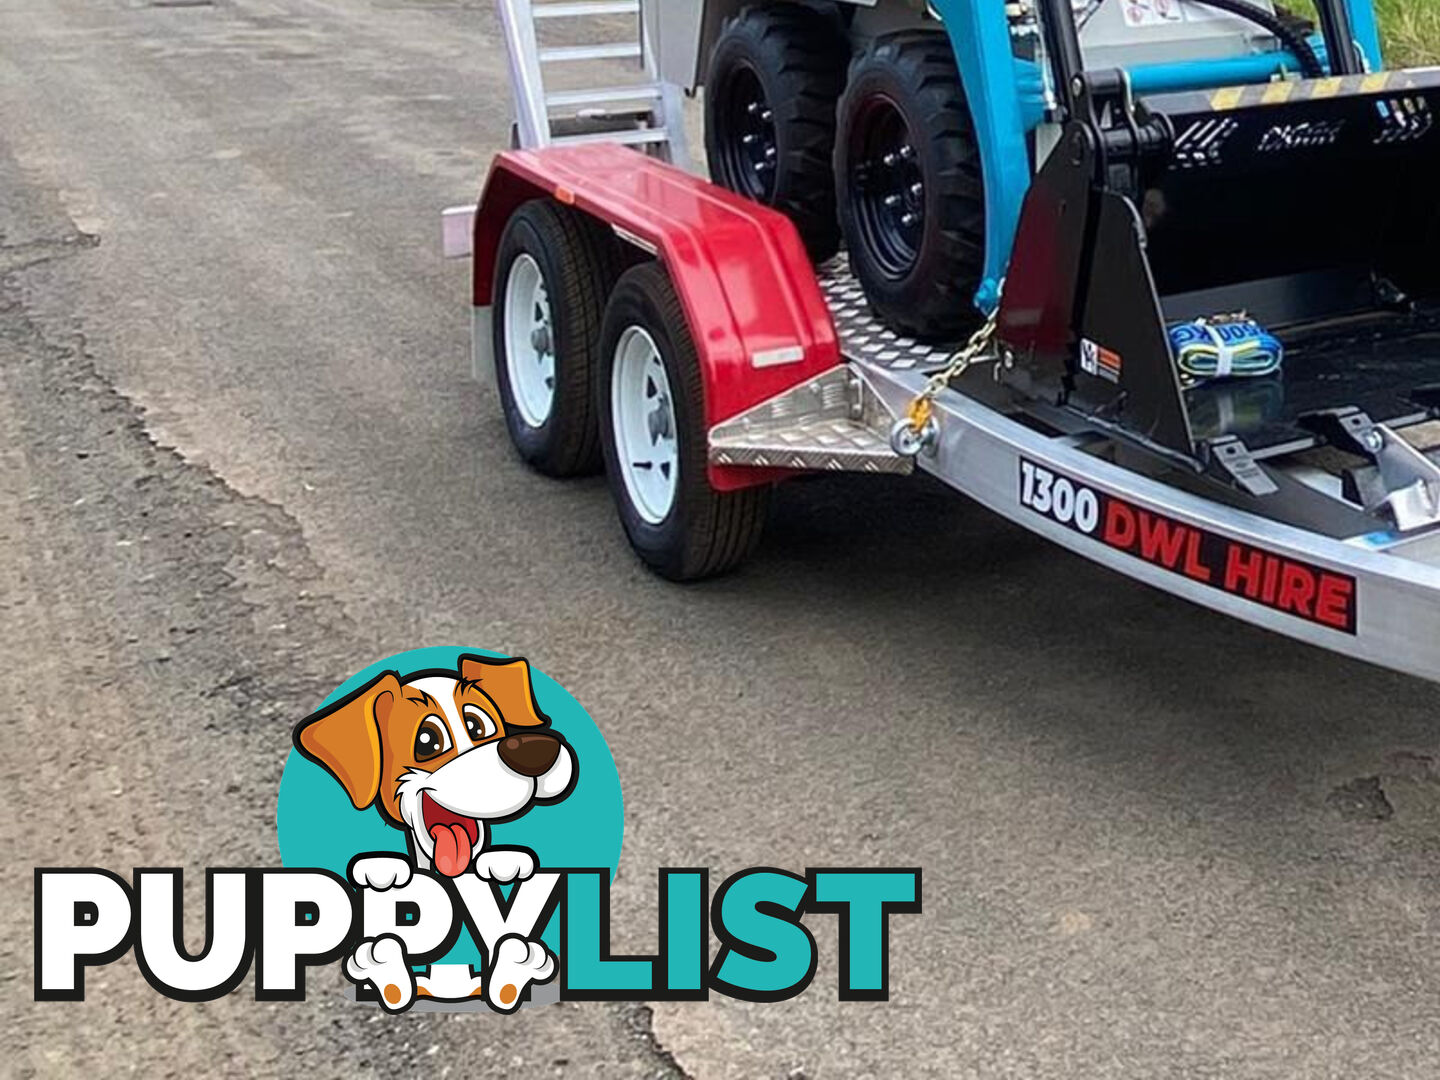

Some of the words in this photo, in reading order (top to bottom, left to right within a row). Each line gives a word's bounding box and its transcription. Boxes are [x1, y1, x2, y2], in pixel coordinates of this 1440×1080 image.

[1021, 460, 1099, 533] 1300
[1104, 499, 1211, 581] DWL
[1224, 544, 1351, 628] HIRE
